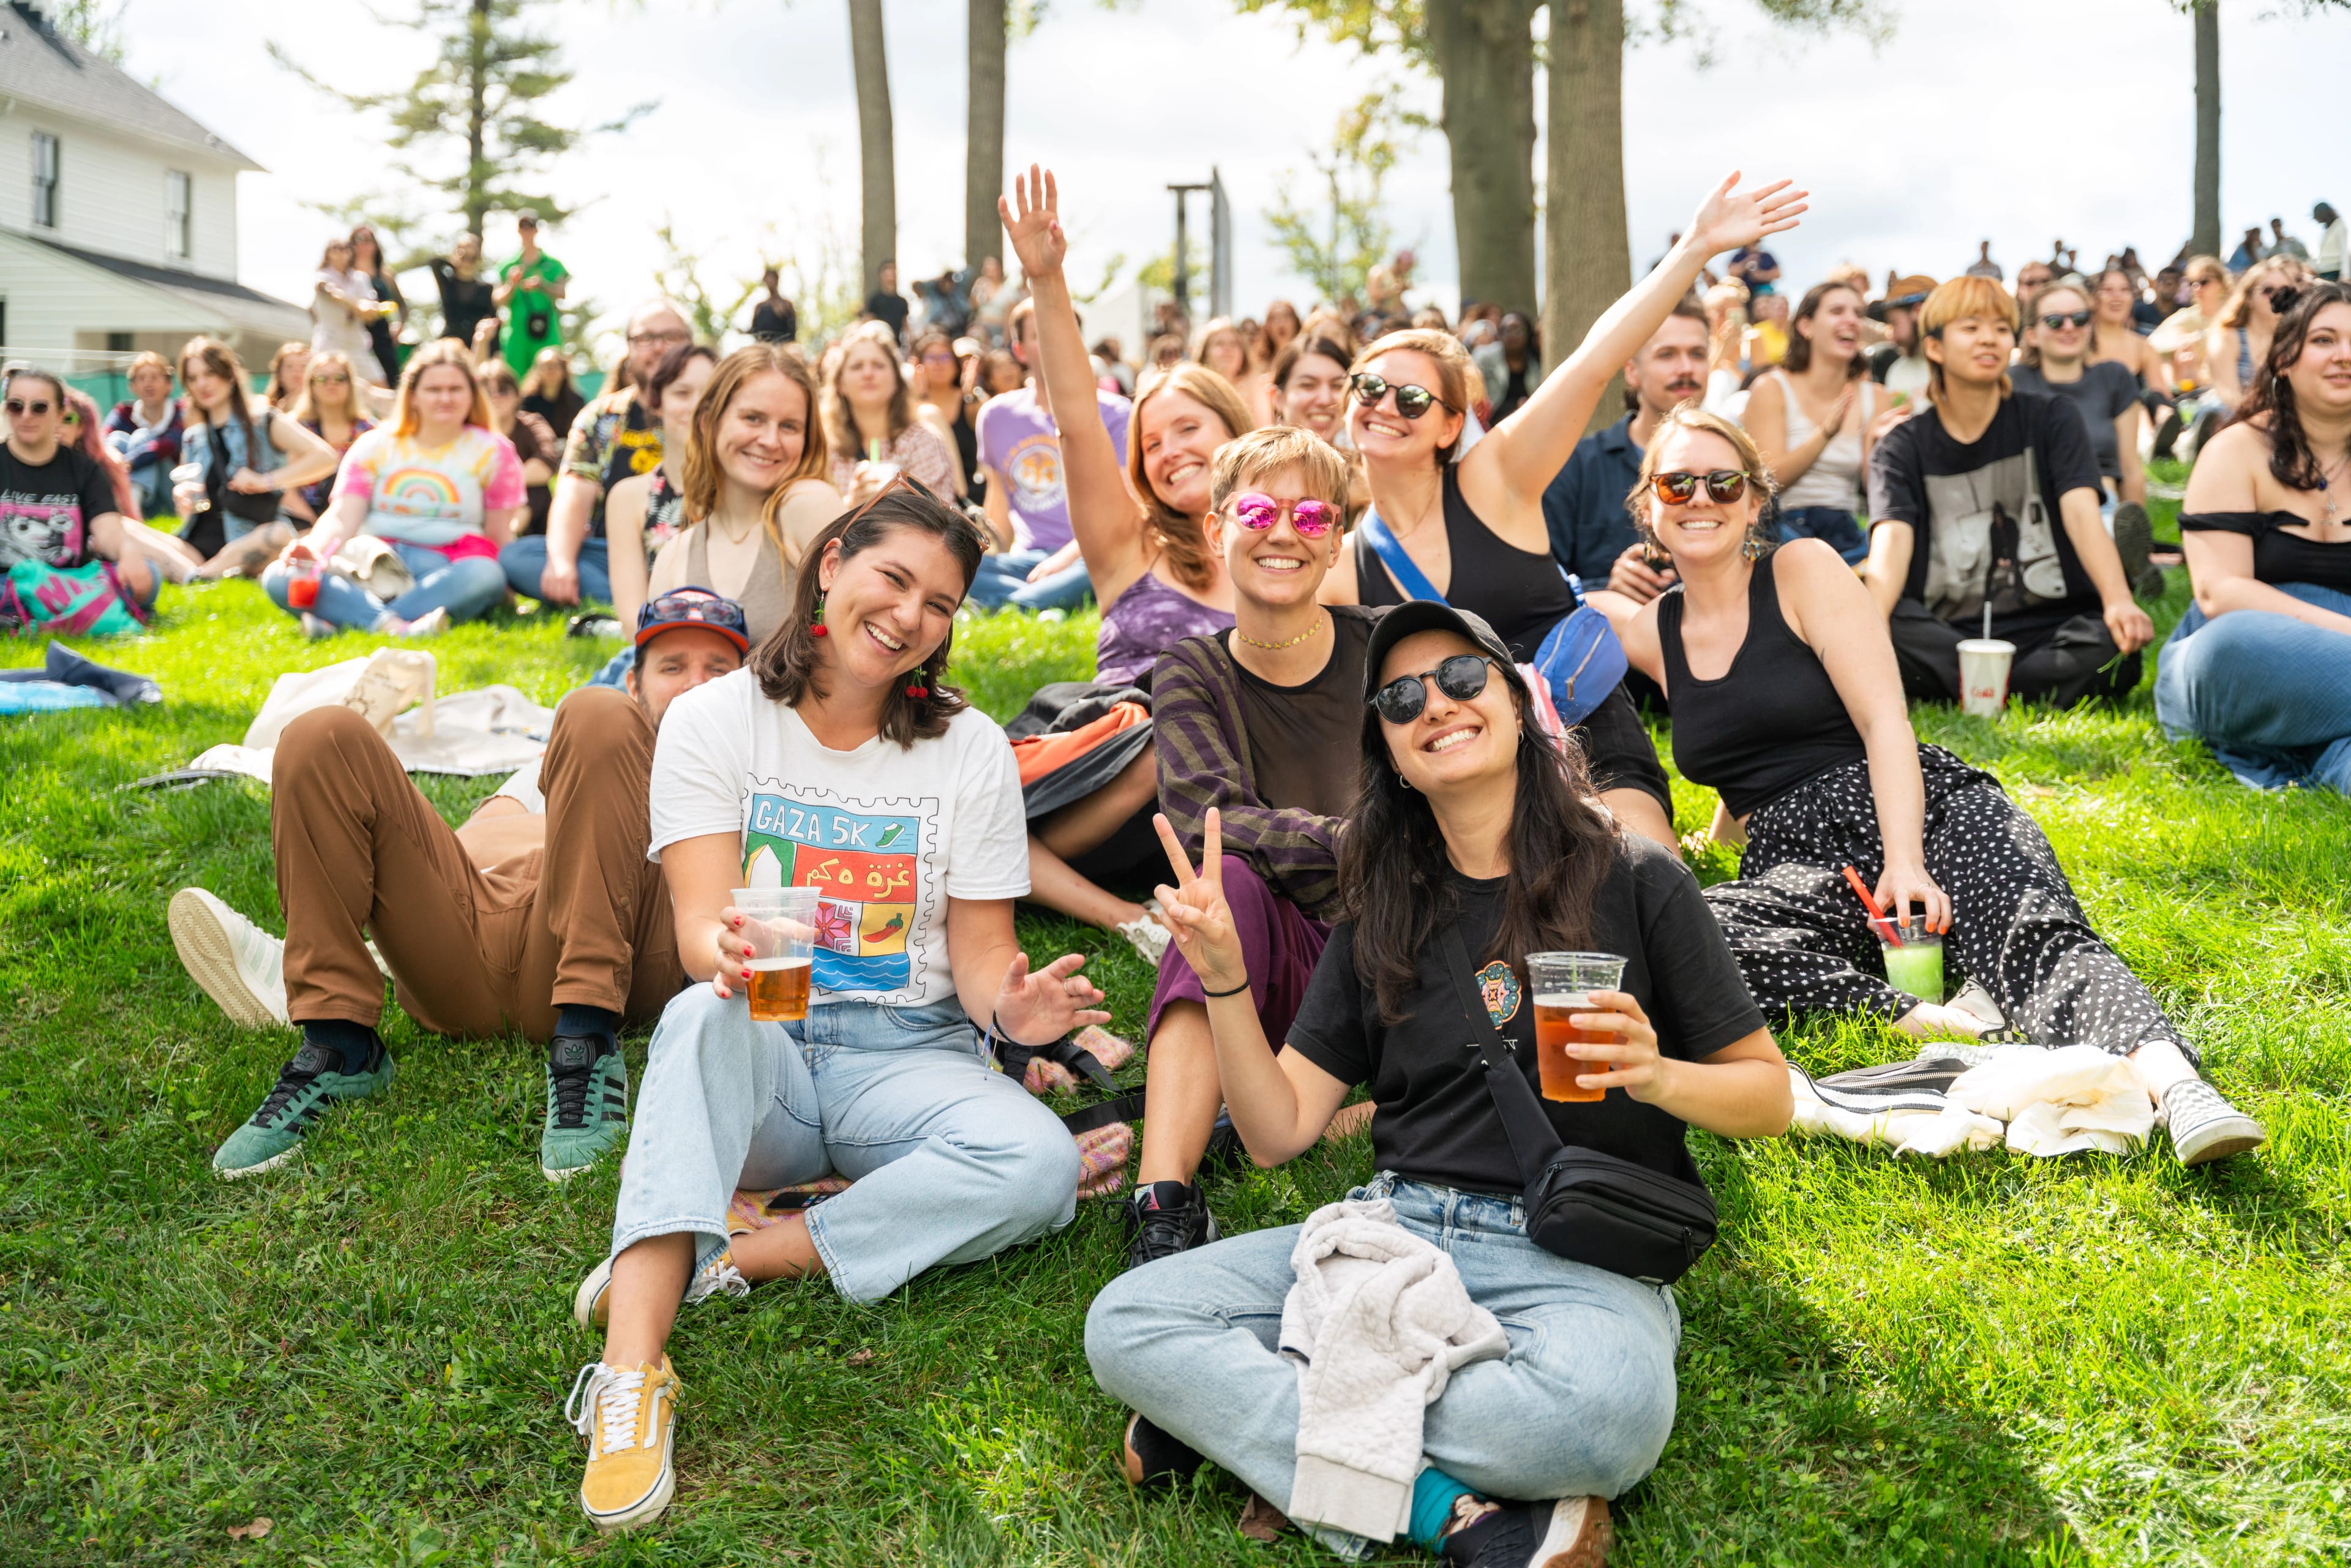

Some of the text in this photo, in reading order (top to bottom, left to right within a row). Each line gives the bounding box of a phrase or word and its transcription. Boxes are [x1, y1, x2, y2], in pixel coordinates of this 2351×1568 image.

[1, 489, 37, 502] LIVE
[756, 800, 872, 847] GAZA 5K
[866, 856, 910, 898] غزة
